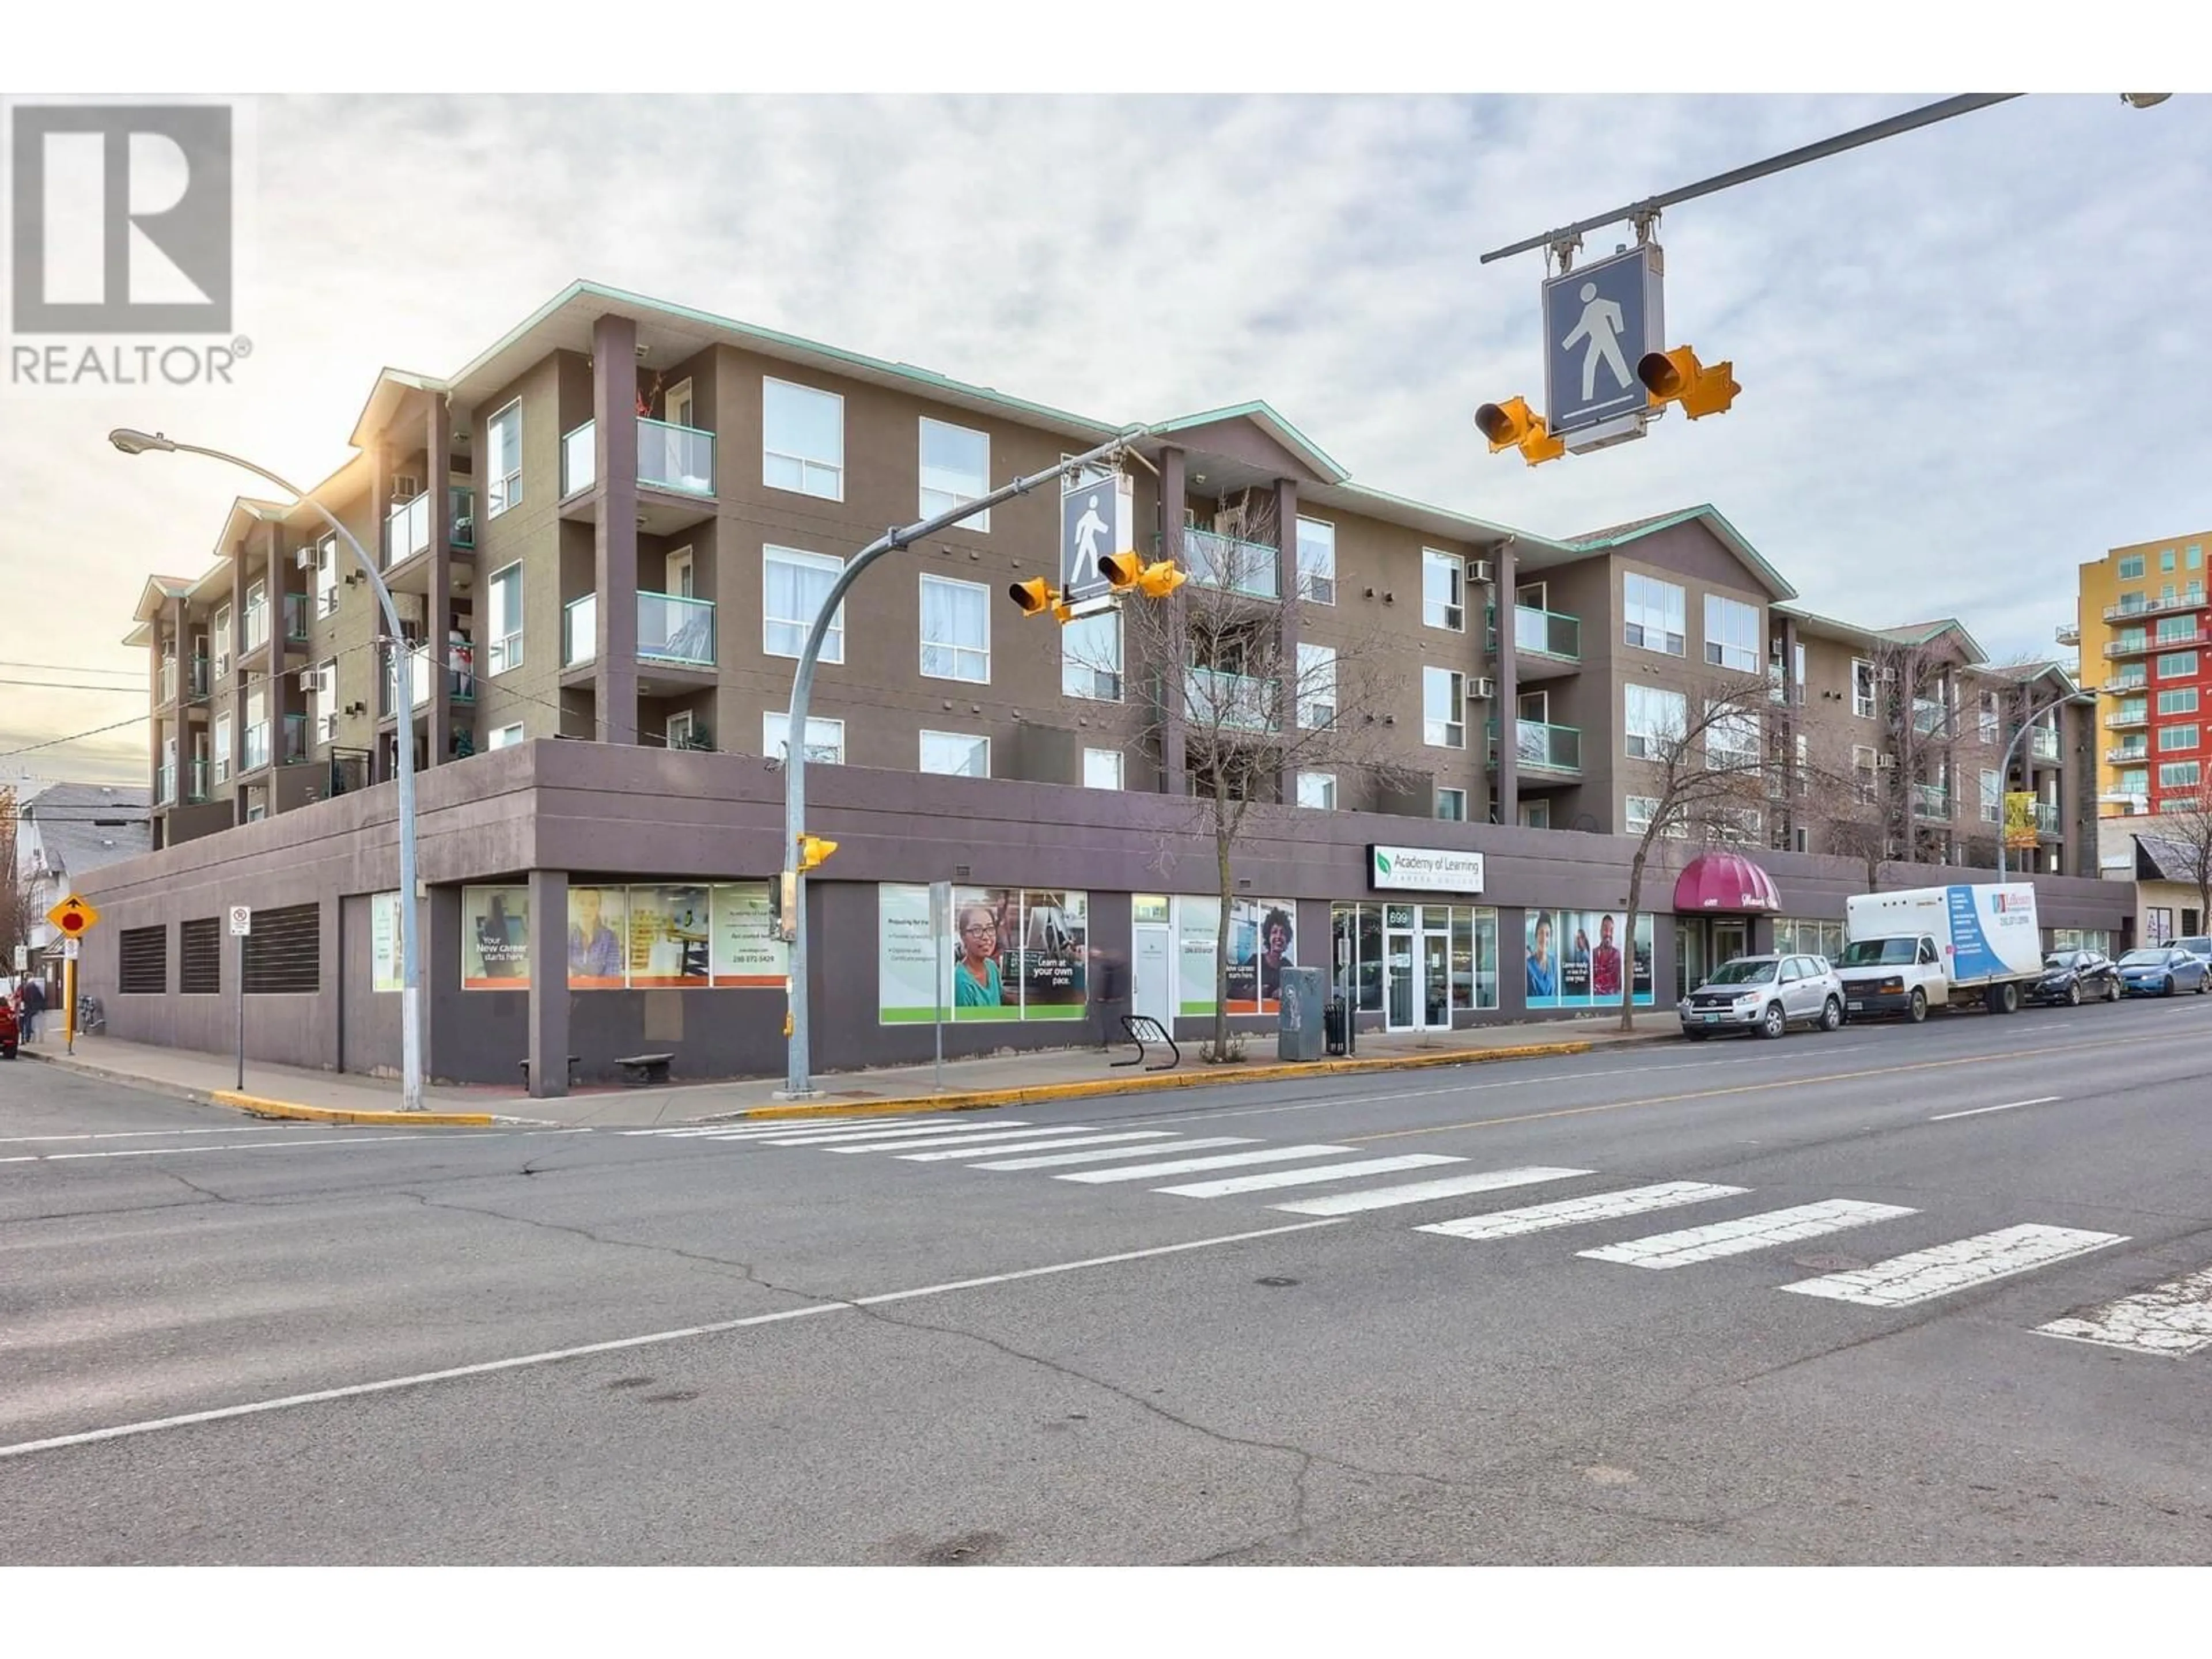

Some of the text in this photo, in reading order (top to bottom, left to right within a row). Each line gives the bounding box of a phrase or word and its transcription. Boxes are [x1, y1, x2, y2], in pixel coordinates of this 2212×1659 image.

[1394, 854, 1479, 874] Academy of Learning
[1389, 912, 1407, 923] 699
[476, 944, 498, 952] New
[1037, 955, 1066, 967] Learn at
[1033, 968, 1053, 978] your
[1052, 977, 1071, 987] pace.
